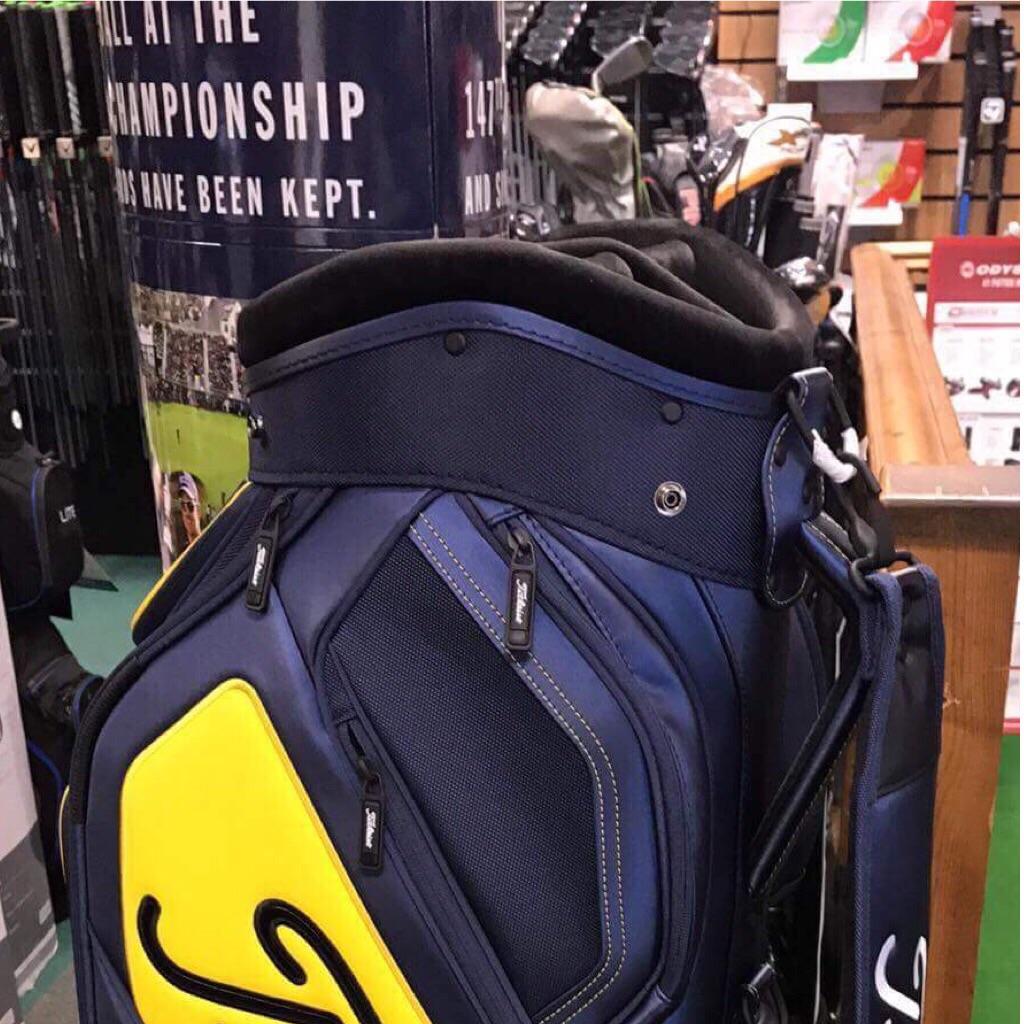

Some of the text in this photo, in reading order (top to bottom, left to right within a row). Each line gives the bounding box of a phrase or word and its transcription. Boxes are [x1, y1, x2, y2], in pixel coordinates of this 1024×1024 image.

[140, 171, 187, 212] HAVE
[196, 174, 264, 217] BEEN
[280, 178, 377, 219] KEPT.
